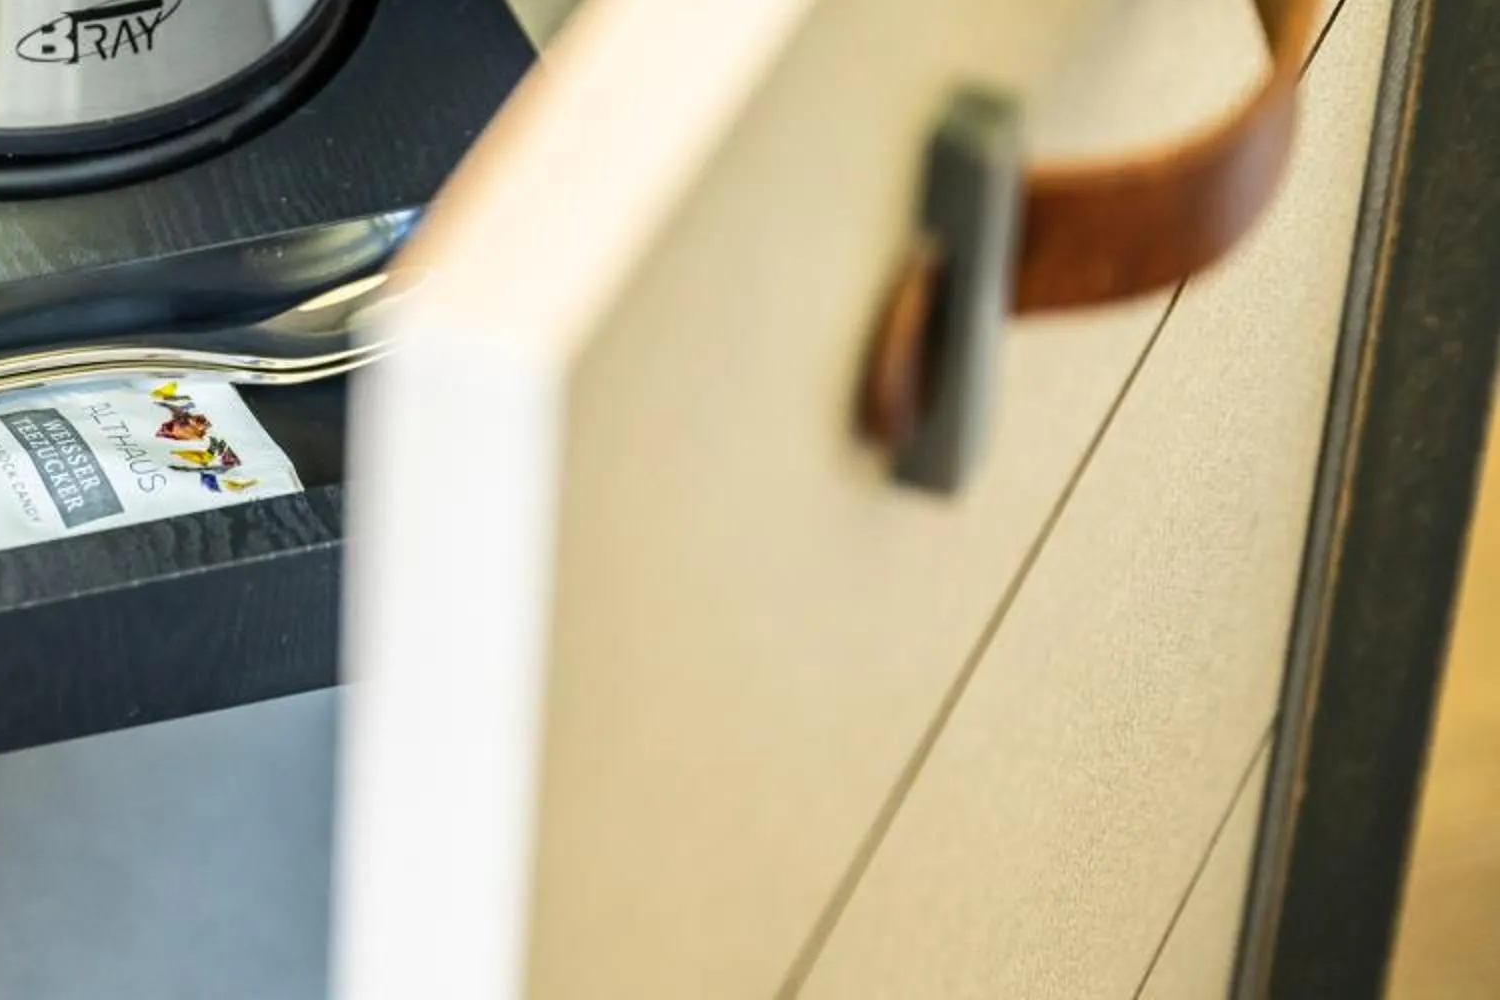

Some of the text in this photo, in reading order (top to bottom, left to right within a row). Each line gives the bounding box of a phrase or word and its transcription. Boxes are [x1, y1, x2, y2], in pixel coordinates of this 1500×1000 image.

[12, 417, 84, 513] TEEZUCKER
[42, 418, 100, 491] WEISSER
[85, 402, 167, 494] ALTHAUS
